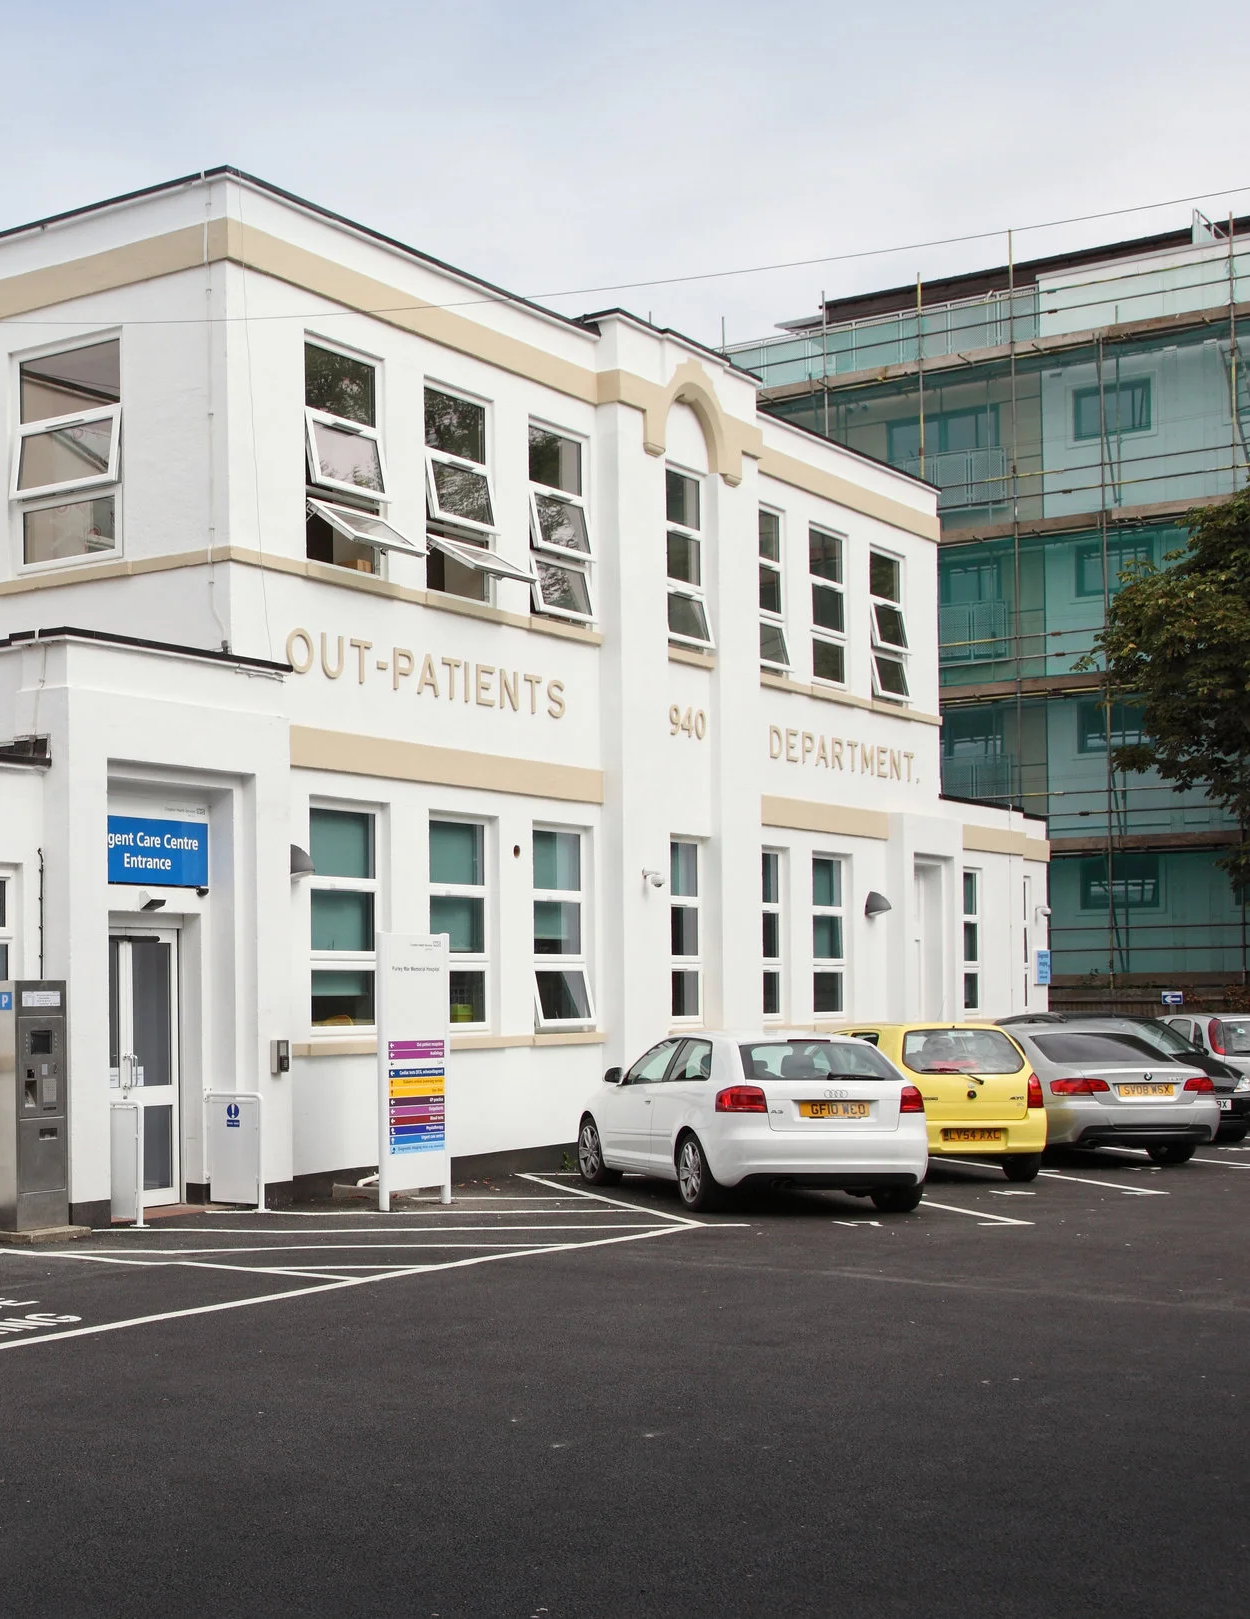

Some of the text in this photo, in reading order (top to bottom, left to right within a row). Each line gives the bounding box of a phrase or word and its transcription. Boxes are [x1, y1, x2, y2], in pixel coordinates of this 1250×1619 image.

[286, 627, 566, 719] OUT-PATIENTS
[669, 704, 707, 740] 940
[136, 832, 161, 848] Care
[163, 834, 199, 850] Centre
[123, 853, 172, 870] Entrance
[1, 994, 9, 1008] P
[811, 1103, 839, 1115] GF10
